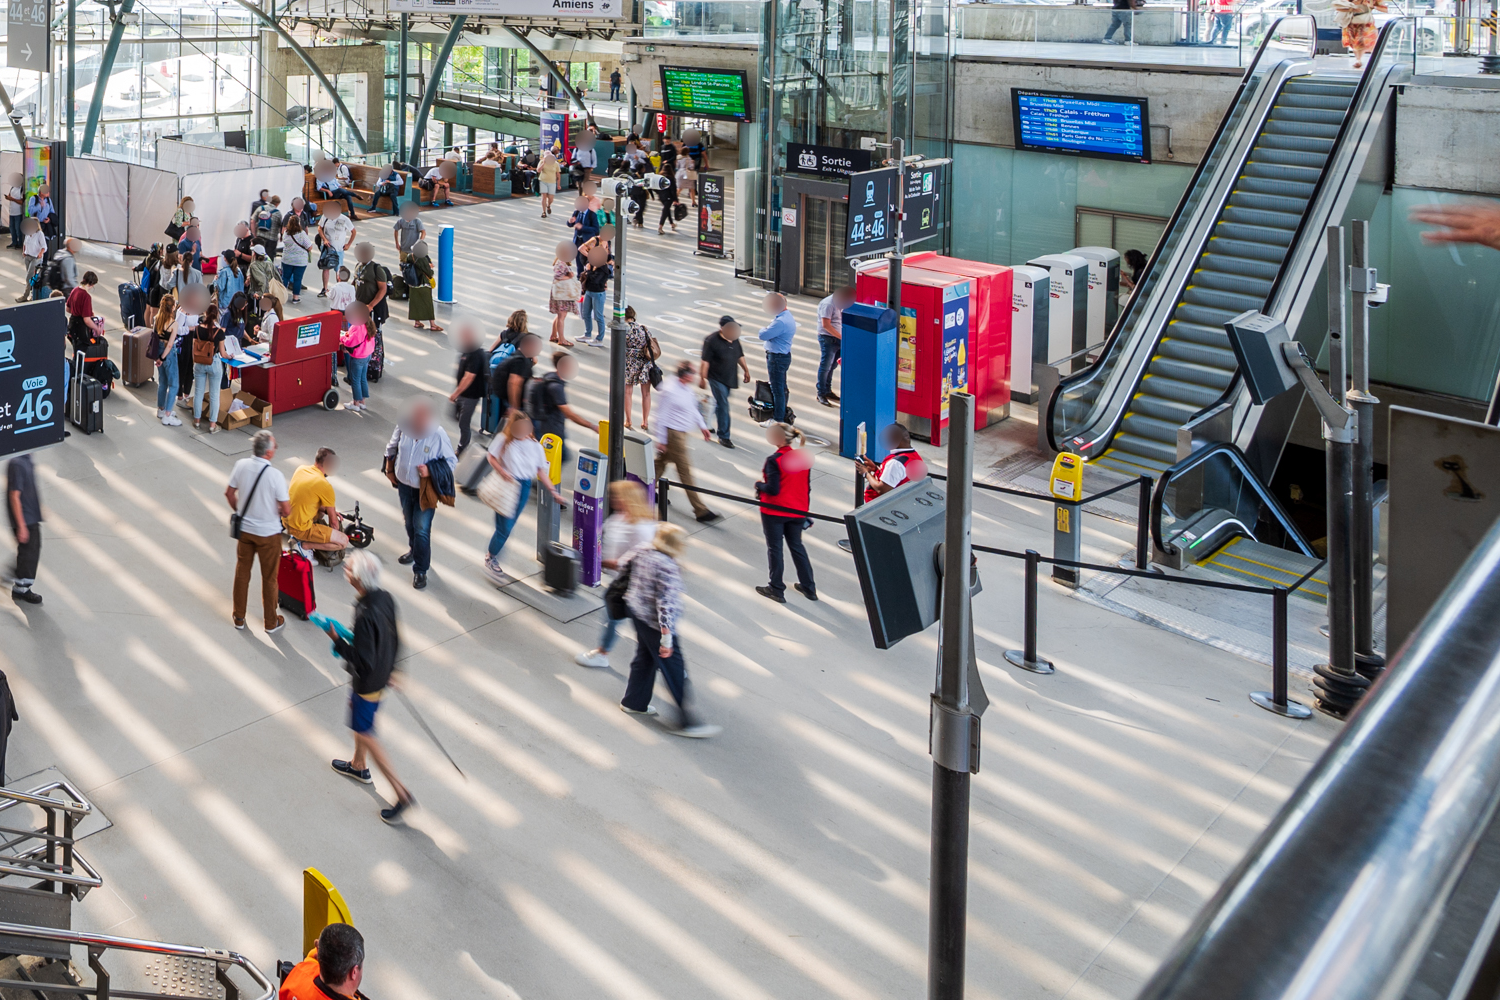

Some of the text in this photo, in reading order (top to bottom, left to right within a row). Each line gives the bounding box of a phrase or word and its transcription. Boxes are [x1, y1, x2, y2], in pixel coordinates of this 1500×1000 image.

[9, 3, 45, 23] 44 et 46
[1084, 110, 1110, 118] Fréthun
[1122, 105, 1139, 150] départs
[822, 155, 852, 167] Sortie
[851, 222, 865, 241] 44
[865, 223, 871, 232] et
[871, 218, 884, 237] 46
[25, 378, 44, 389] Voie
[15, 388, 54, 425] 46
[574, 499, 594, 511] Validez
